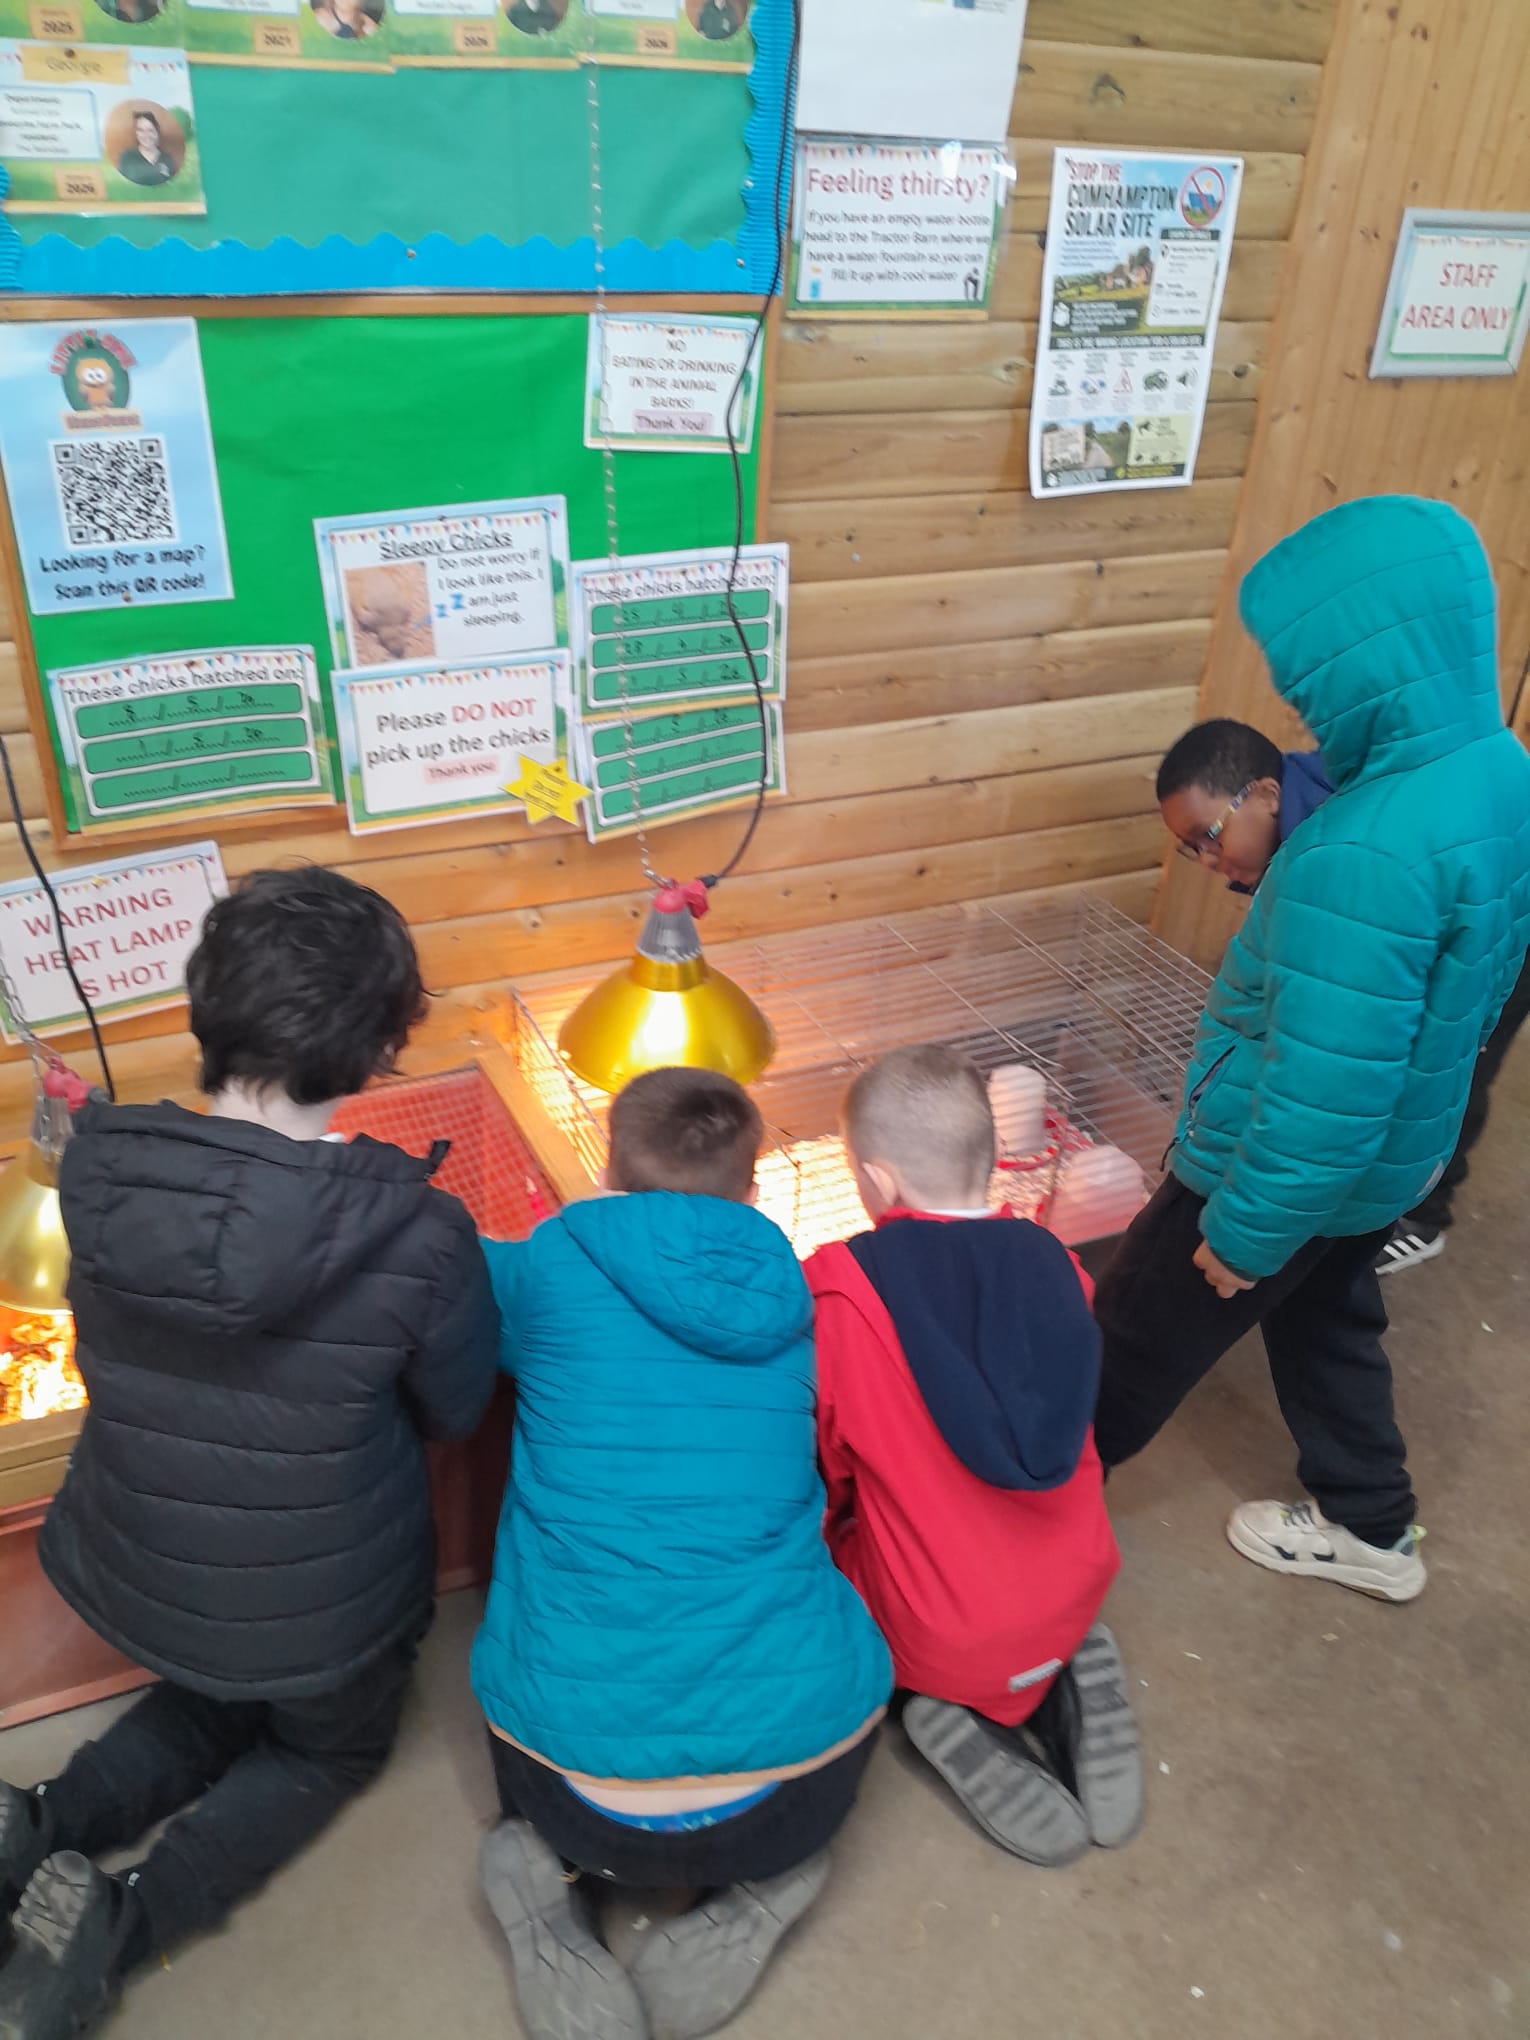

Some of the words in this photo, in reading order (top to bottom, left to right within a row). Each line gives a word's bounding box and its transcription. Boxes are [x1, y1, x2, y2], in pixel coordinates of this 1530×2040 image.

[1068, 161, 1098, 181] STOP
[1100, 162, 1121, 182] THE
[807, 169, 893, 200] Feeling
[901, 169, 990, 203] thirsty?
[842, 211, 868, 224] have
[888, 214, 921, 226] empty
[926, 215, 953, 224] water
[1065, 210, 1117, 237] SOLAR
[1120, 212, 1155, 238] SITE
[850, 232, 868, 242] the
[913, 232, 939, 243] Barn
[808, 251, 834, 262] have
[847, 253, 875, 262] water
[880, 250, 927, 263] fountain
[1440, 262, 1498, 287] STAFF
[1402, 304, 1455, 329] AREA
[1460, 306, 1513, 329] ONLY
[612, 355, 656, 369] EATING
[659, 358, 675, 369] OR
[678, 358, 737, 375] DRINKING
[630, 377, 642, 387] IN
[645, 376, 666, 389] THE
[671, 378, 716, 391] ANIMAL
[379, 537, 446, 561] Sleepy
[449, 529, 513, 553] Chicks
[40, 554, 109, 573] Looking
[113, 550, 139, 567] for
[145, 552, 155, 564] a
[160, 544, 206, 566] map?
[438, 557, 456, 571] Do
[460, 554, 485, 568] not
[487, 552, 527, 567] worry
[55, 582, 94, 599] Scan
[99, 577, 130, 596] this
[133, 577, 157, 593] QR
[161, 573, 205, 592] code!
[446, 574, 475, 589] look
[479, 571, 504, 585] like
[635, 580, 682, 597] chicks
[468, 596, 490, 607] am
[490, 592, 519, 608] just
[64, 684, 124, 704] These
[128, 675, 187, 695] chicks
[190, 667, 270, 688] hatched
[376, 711, 447, 733] Please
[451, 704, 484, 724] DO
[490, 697, 537, 719] NOT
[366, 744, 411, 769] pick
[416, 743, 444, 761] up
[448, 735, 484, 755] the
[488, 726, 551, 750] chicks
[23, 888, 173, 938] WARNING
[24, 940, 103, 976] HEAT
[110, 918, 193, 954] LAMP
[106, 960, 168, 993] HOT
